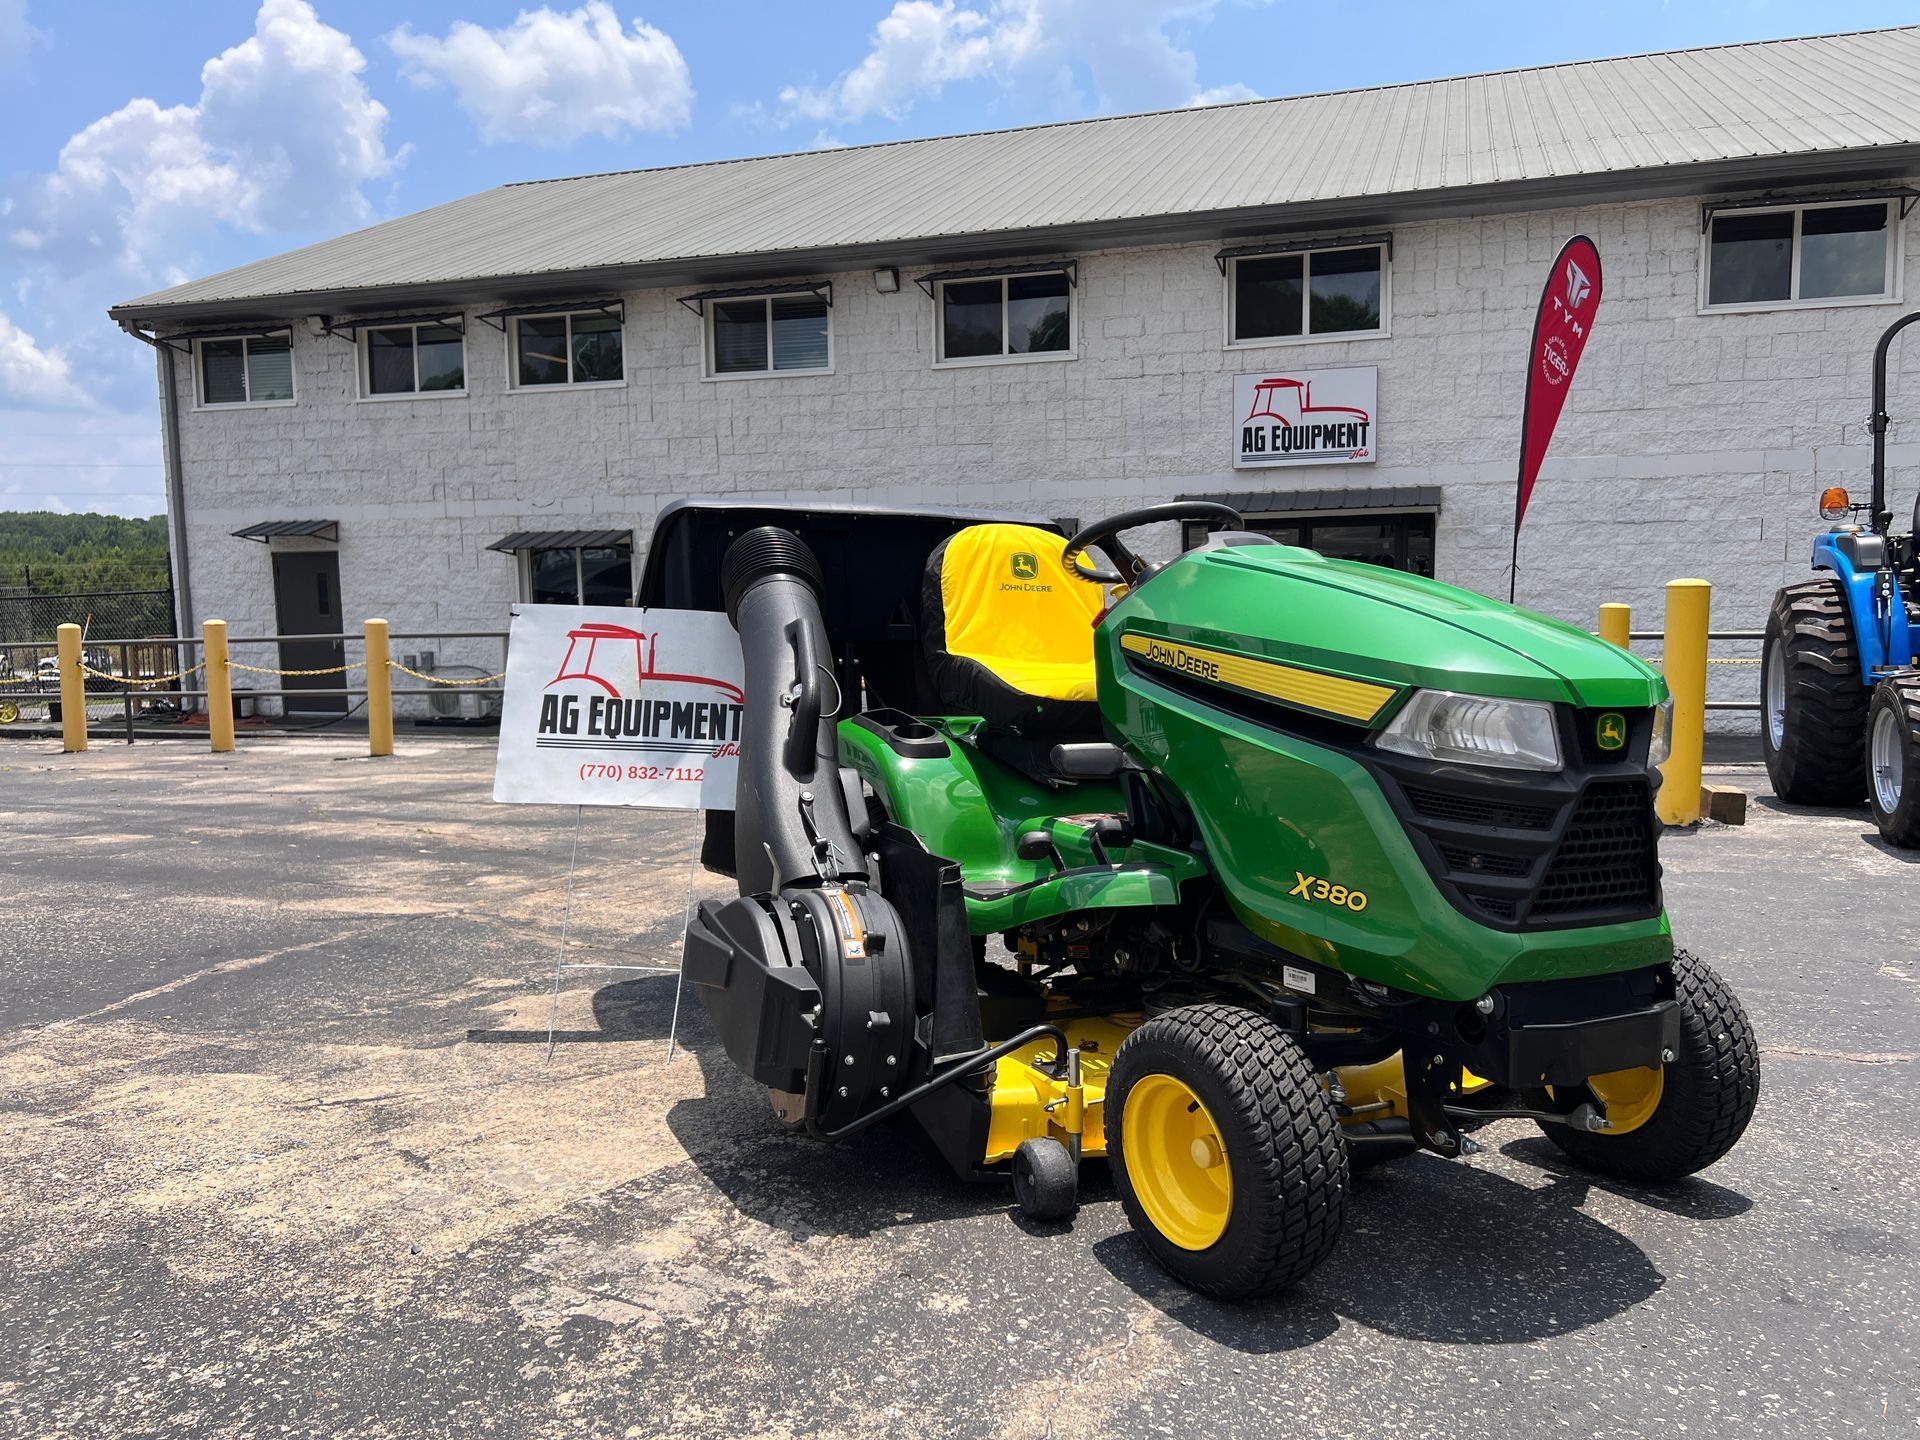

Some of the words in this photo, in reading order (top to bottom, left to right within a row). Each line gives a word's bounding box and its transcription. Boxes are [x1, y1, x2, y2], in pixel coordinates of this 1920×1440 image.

[1554, 296, 1583, 339] TYM
[1543, 343, 1569, 376] TIGER
[1242, 426, 1266, 453] AG
[1271, 422, 1370, 453] EQUIPMENT
[1348, 448, 1369, 460] Hub
[1000, 583, 1022, 591] JOHN
[1024, 584, 1052, 592] DEERE
[1145, 640, 1175, 668] JOHN
[1177, 649, 1219, 680] DEERE
[538, 694, 579, 734] AG
[587, 695, 744, 742] EQUIPMENT
[580, 764, 623, 782] (770)
[628, 766, 704, 782] 832-7112
[1288, 871, 1367, 911] X380
